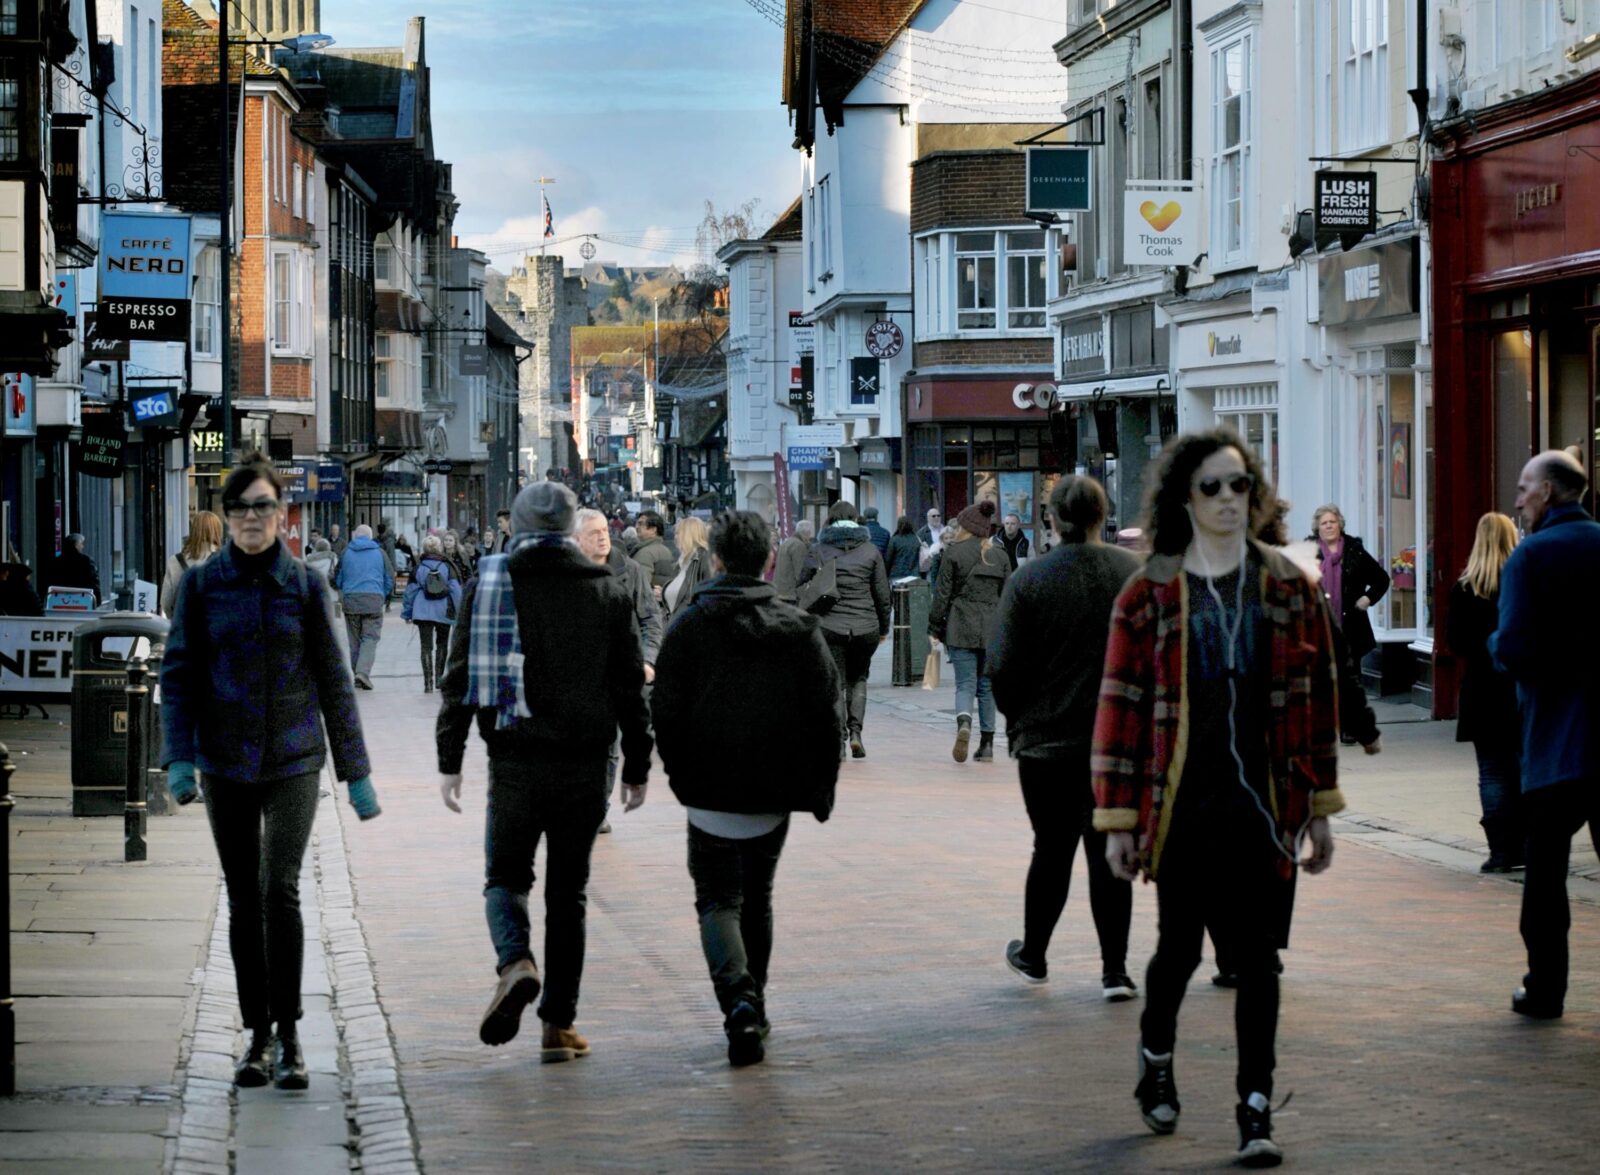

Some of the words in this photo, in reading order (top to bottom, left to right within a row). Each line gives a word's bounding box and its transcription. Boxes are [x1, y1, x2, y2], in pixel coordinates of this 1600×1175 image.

[1321, 180, 1370, 194] LUSH
[1321, 195, 1370, 208] FRESH
[1321, 208, 1369, 216] HANDMADE
[1321, 216, 1369, 225] COSMETICS
[1139, 234, 1183, 245] Thomas
[1146, 246, 1174, 256] Cook
[107, 256, 184, 274] NERO
[109, 303, 177, 316] ESPRESSO
[130, 319, 155, 330] BAR
[872, 323, 897, 334] COSTA
[92, 339, 122, 350] Hut
[870, 343, 899, 356] COFFEE
[137, 398, 167, 416] sta
[87, 435, 121, 449] HOLLAND
[98, 445, 107, 454] &
[84, 452, 118, 466] BARRETT
